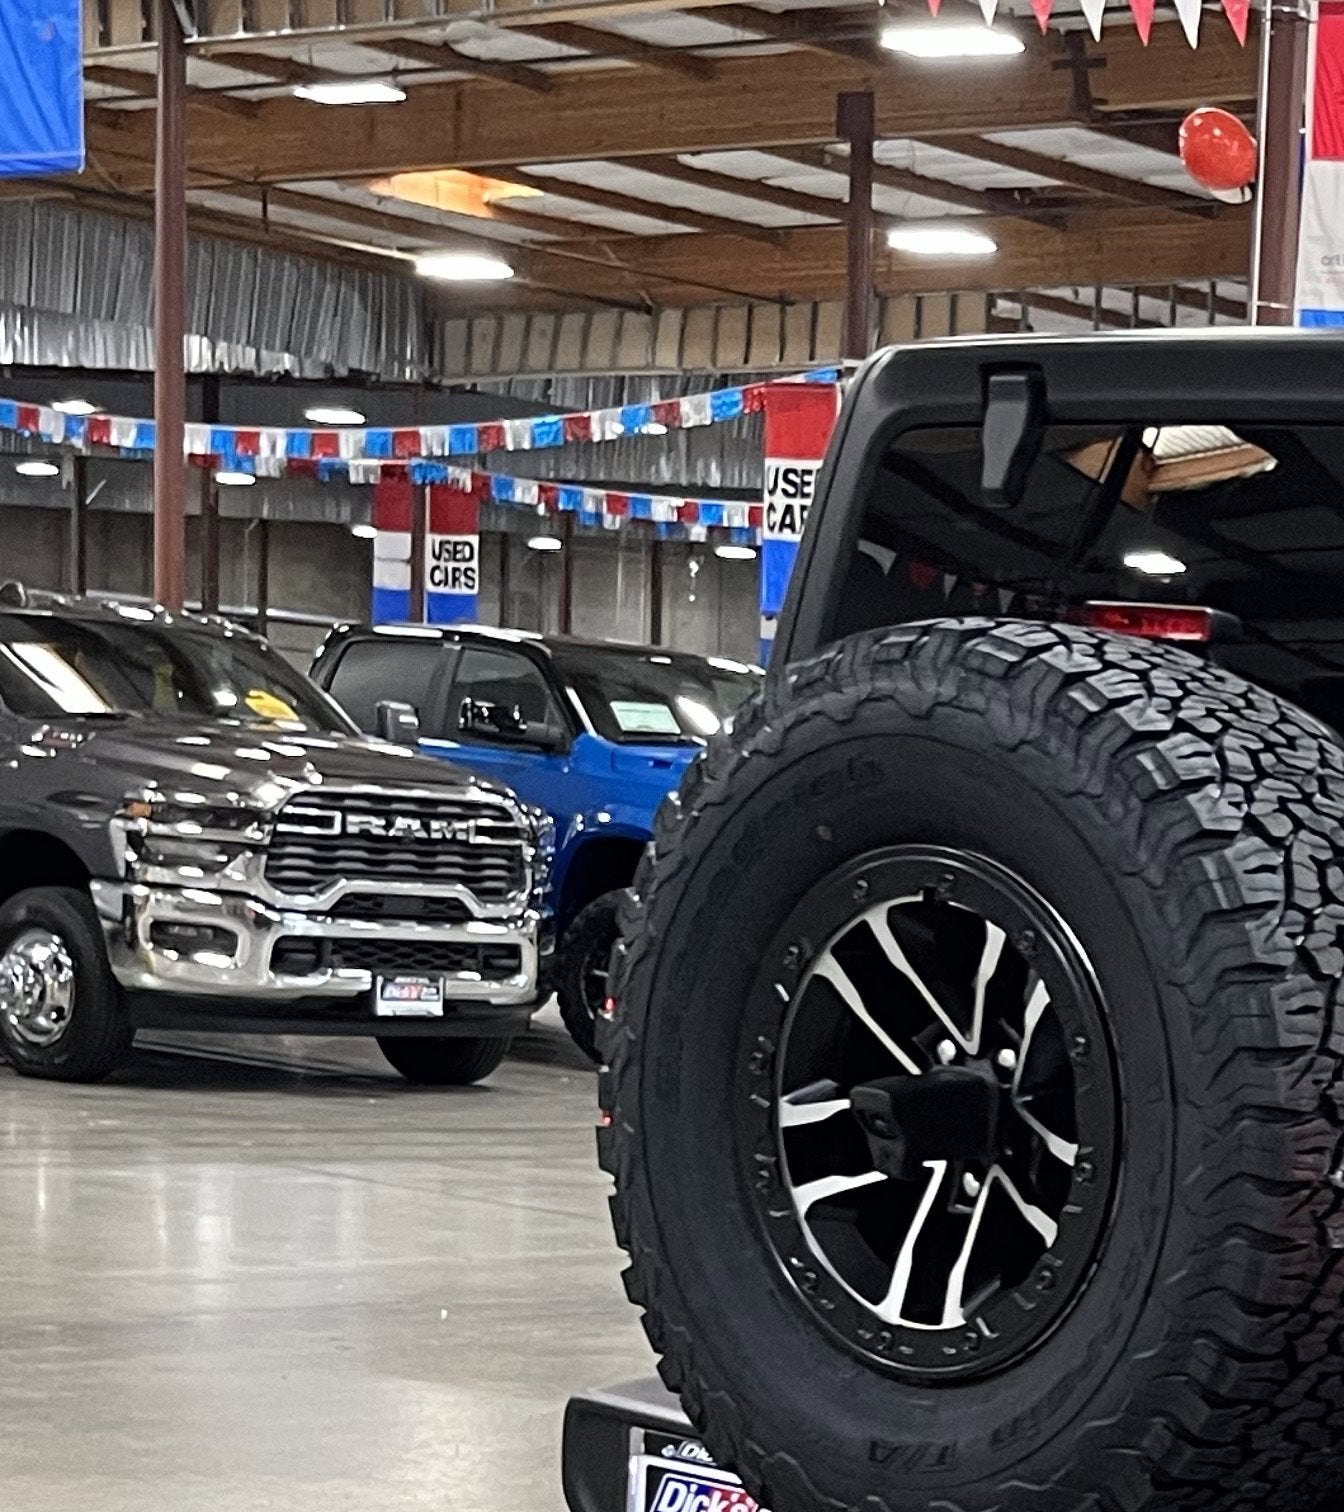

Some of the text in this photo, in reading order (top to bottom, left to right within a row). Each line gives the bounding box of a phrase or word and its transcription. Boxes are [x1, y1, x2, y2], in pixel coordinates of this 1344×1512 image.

[767, 466, 813, 498] USE
[766, 502, 808, 534] CA
[431, 538, 474, 562] USED
[345, 815, 468, 841] RAM
